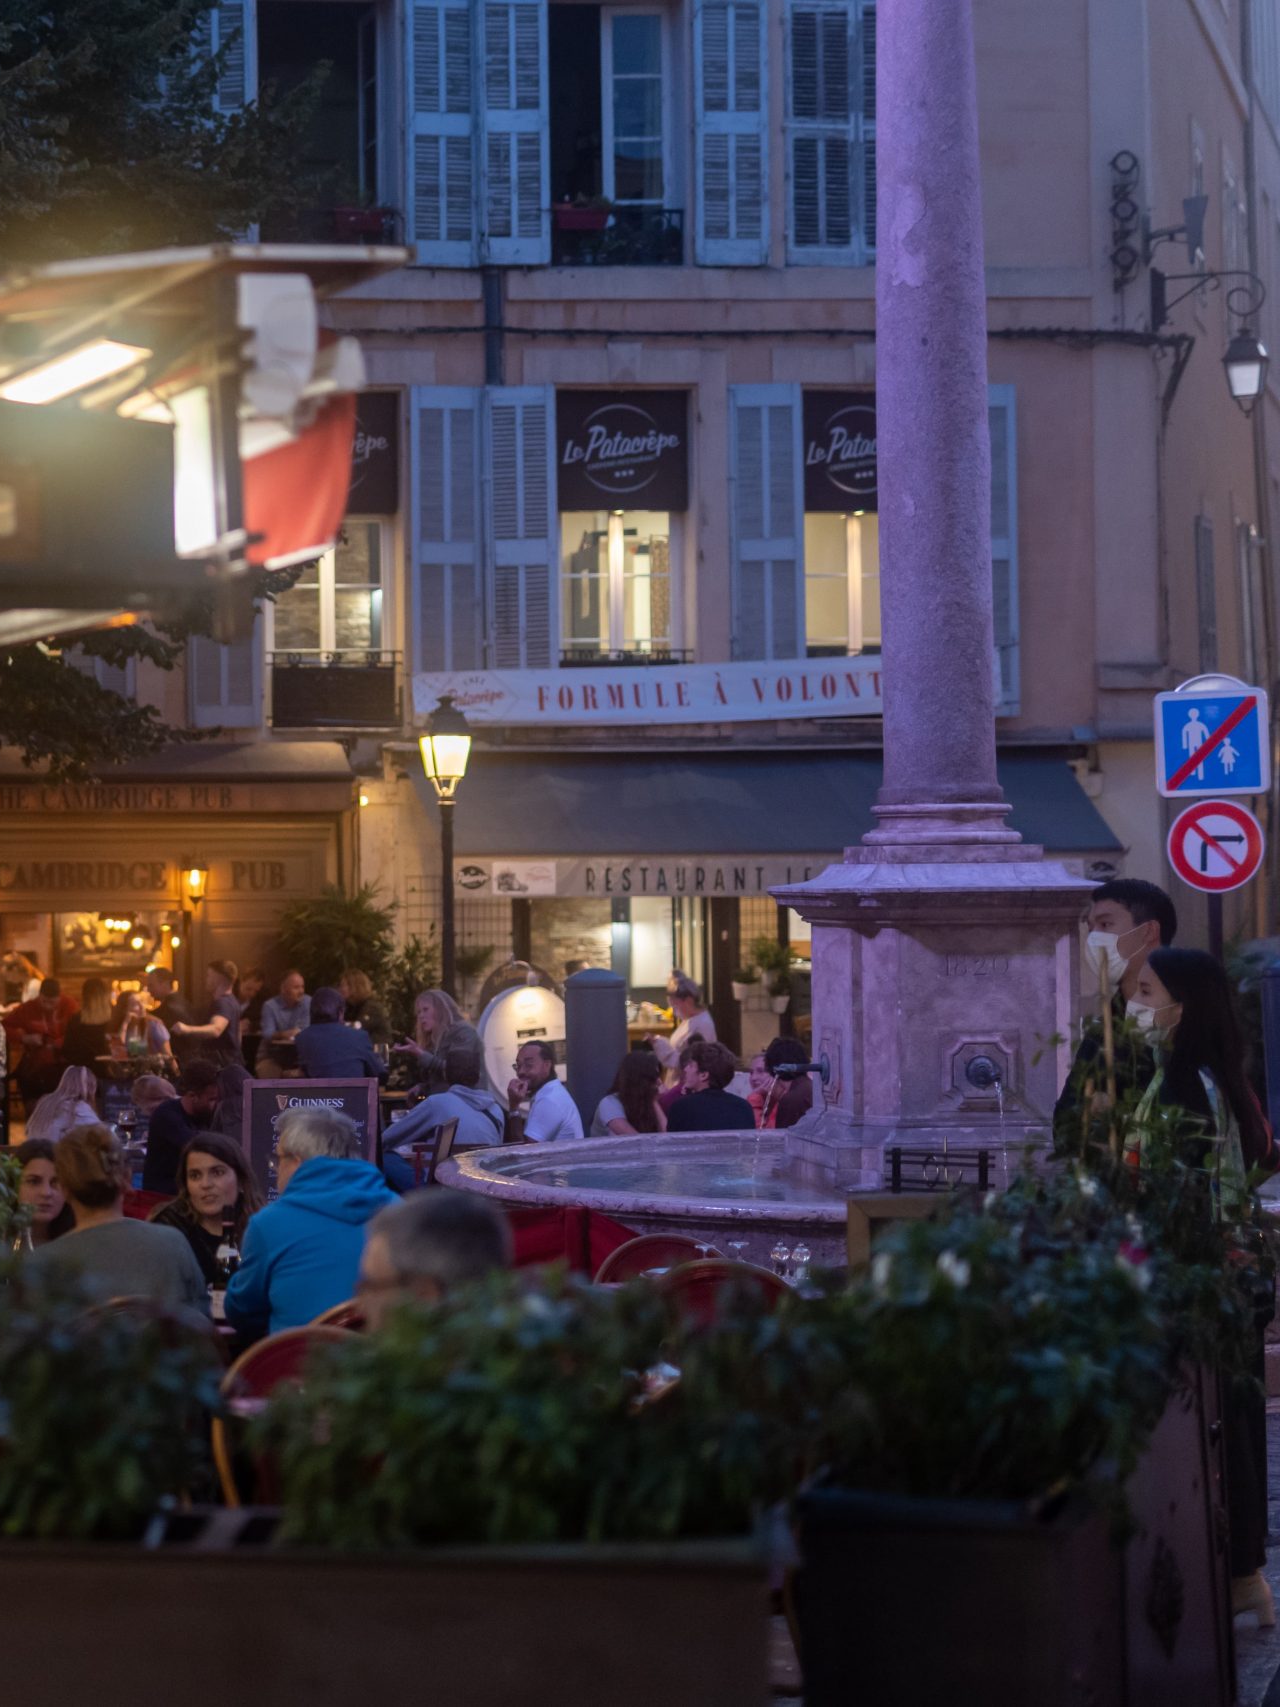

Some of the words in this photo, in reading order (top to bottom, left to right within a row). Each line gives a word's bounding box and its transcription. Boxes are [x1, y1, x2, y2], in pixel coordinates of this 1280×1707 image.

[562, 440, 585, 464] Le
[584, 424, 680, 462] Patacrêpe
[806, 441, 826, 465] Le
[537, 680, 691, 711] FORMULE
[713, 671, 728, 705] À
[40, 786, 179, 809] CAMBRIDGE
[188, 786, 233, 809] PUB
[231, 861, 287, 890] PUB
[586, 866, 765, 892] RESTAURANT
[288, 1097, 345, 1109] GUINNESS
